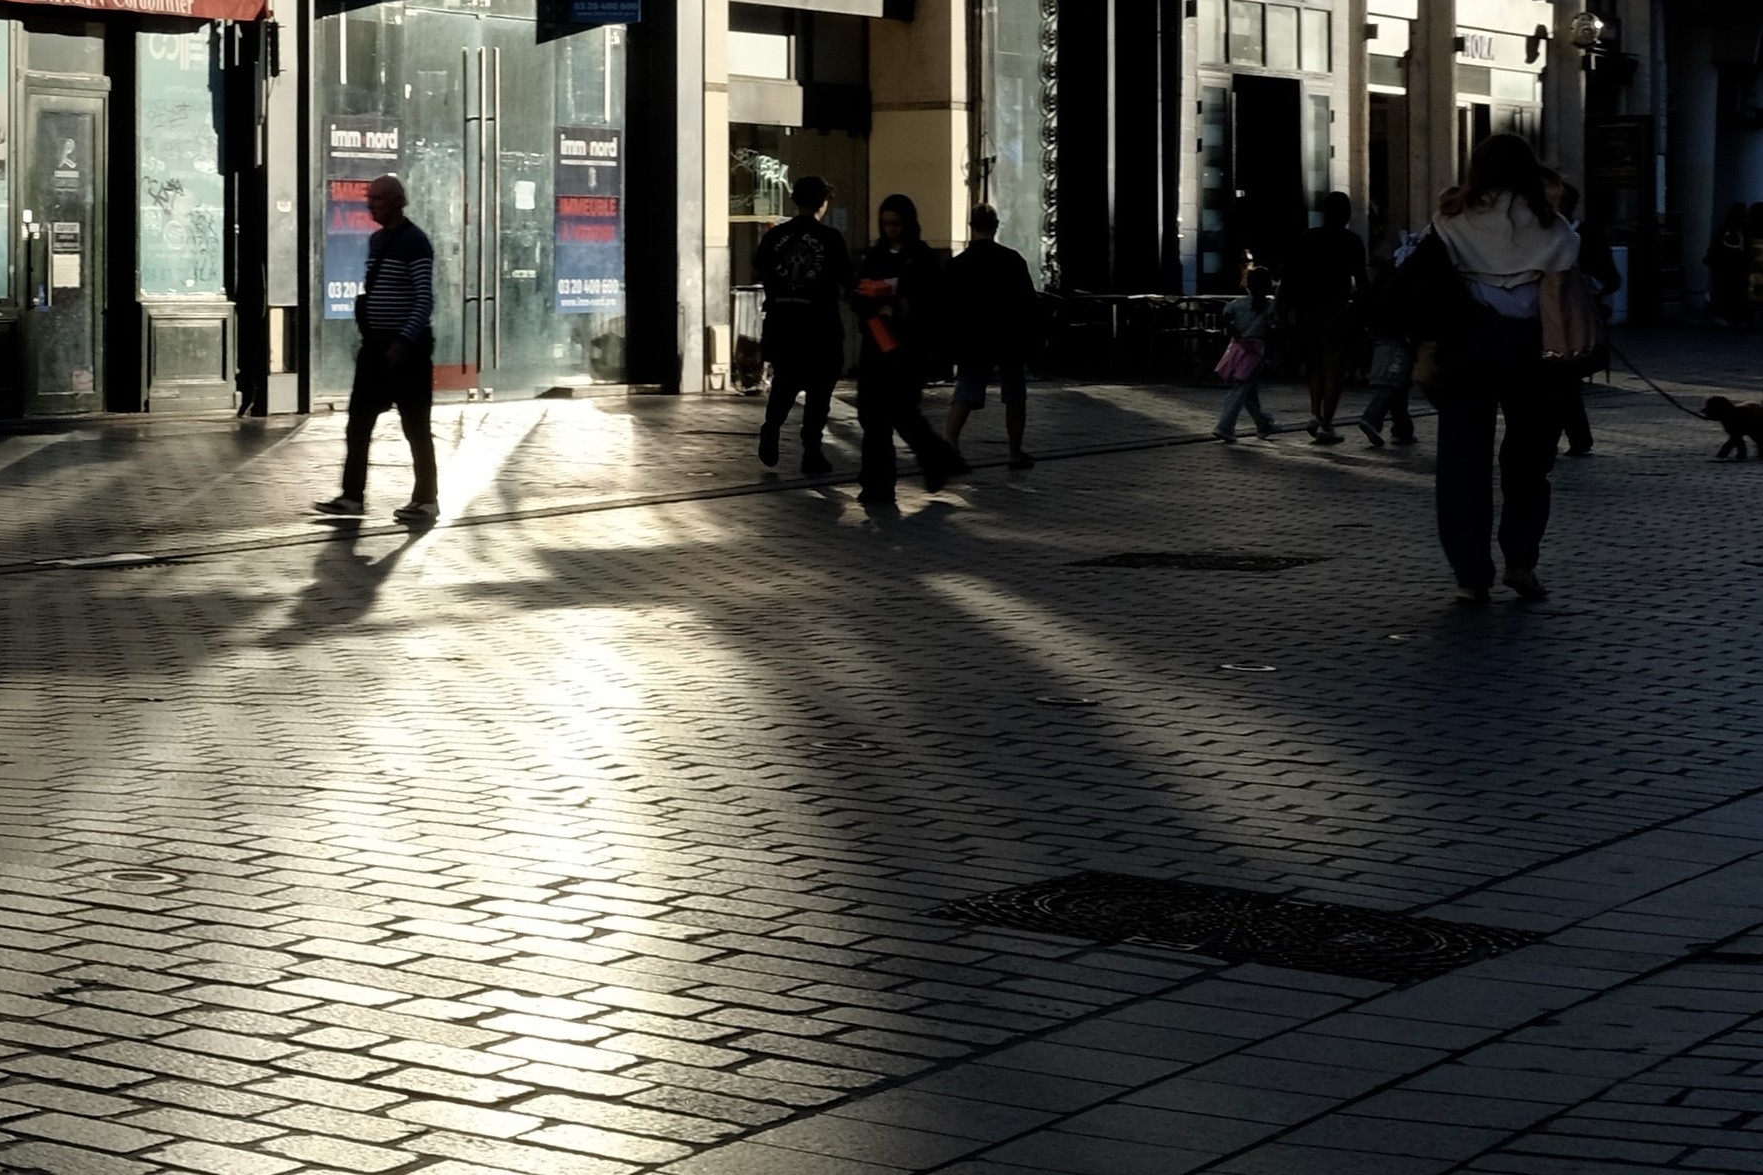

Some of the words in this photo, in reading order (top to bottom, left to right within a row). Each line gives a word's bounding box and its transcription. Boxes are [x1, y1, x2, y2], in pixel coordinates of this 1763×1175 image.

[328, 281, 342, 299] 03
[343, 281, 357, 299] 20
[558, 279, 571, 294] 03
[572, 279, 583, 294] 20
